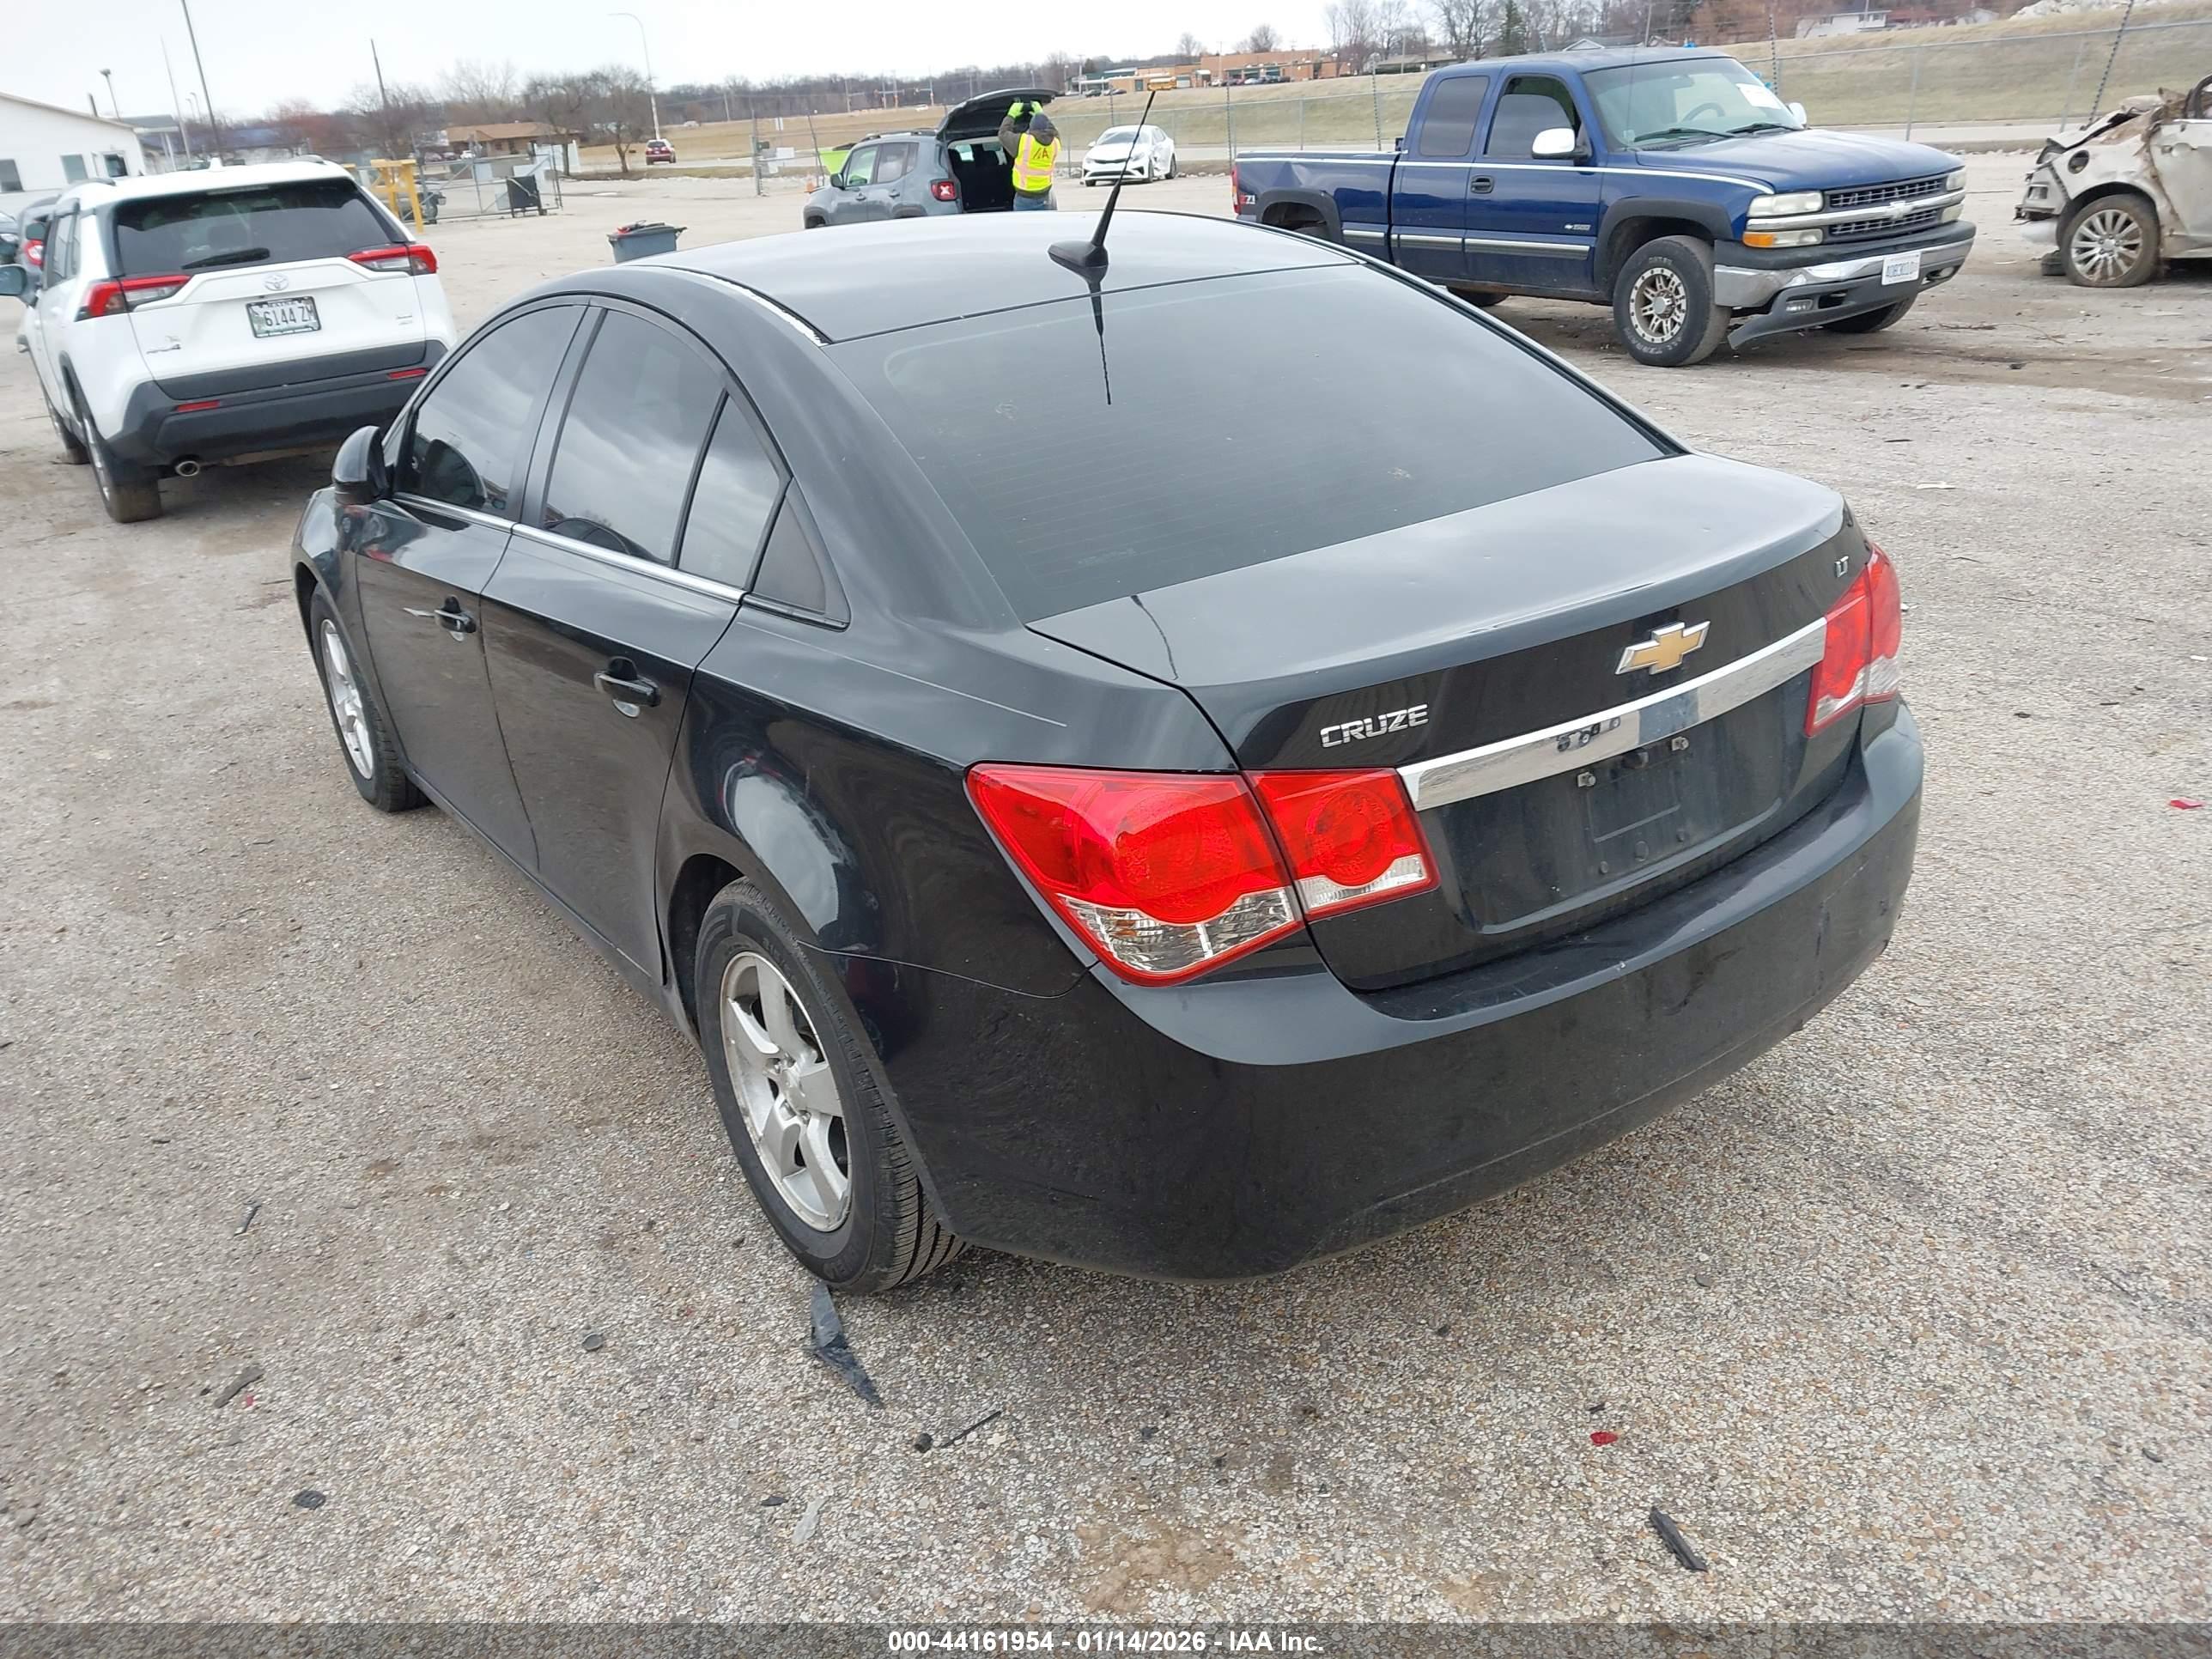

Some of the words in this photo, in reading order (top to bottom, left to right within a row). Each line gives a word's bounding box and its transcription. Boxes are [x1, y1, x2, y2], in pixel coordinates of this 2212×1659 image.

[264, 307, 297, 327] 6144
[1836, 556, 1849, 578] LT
[1320, 703, 1430, 748] CRUZE
